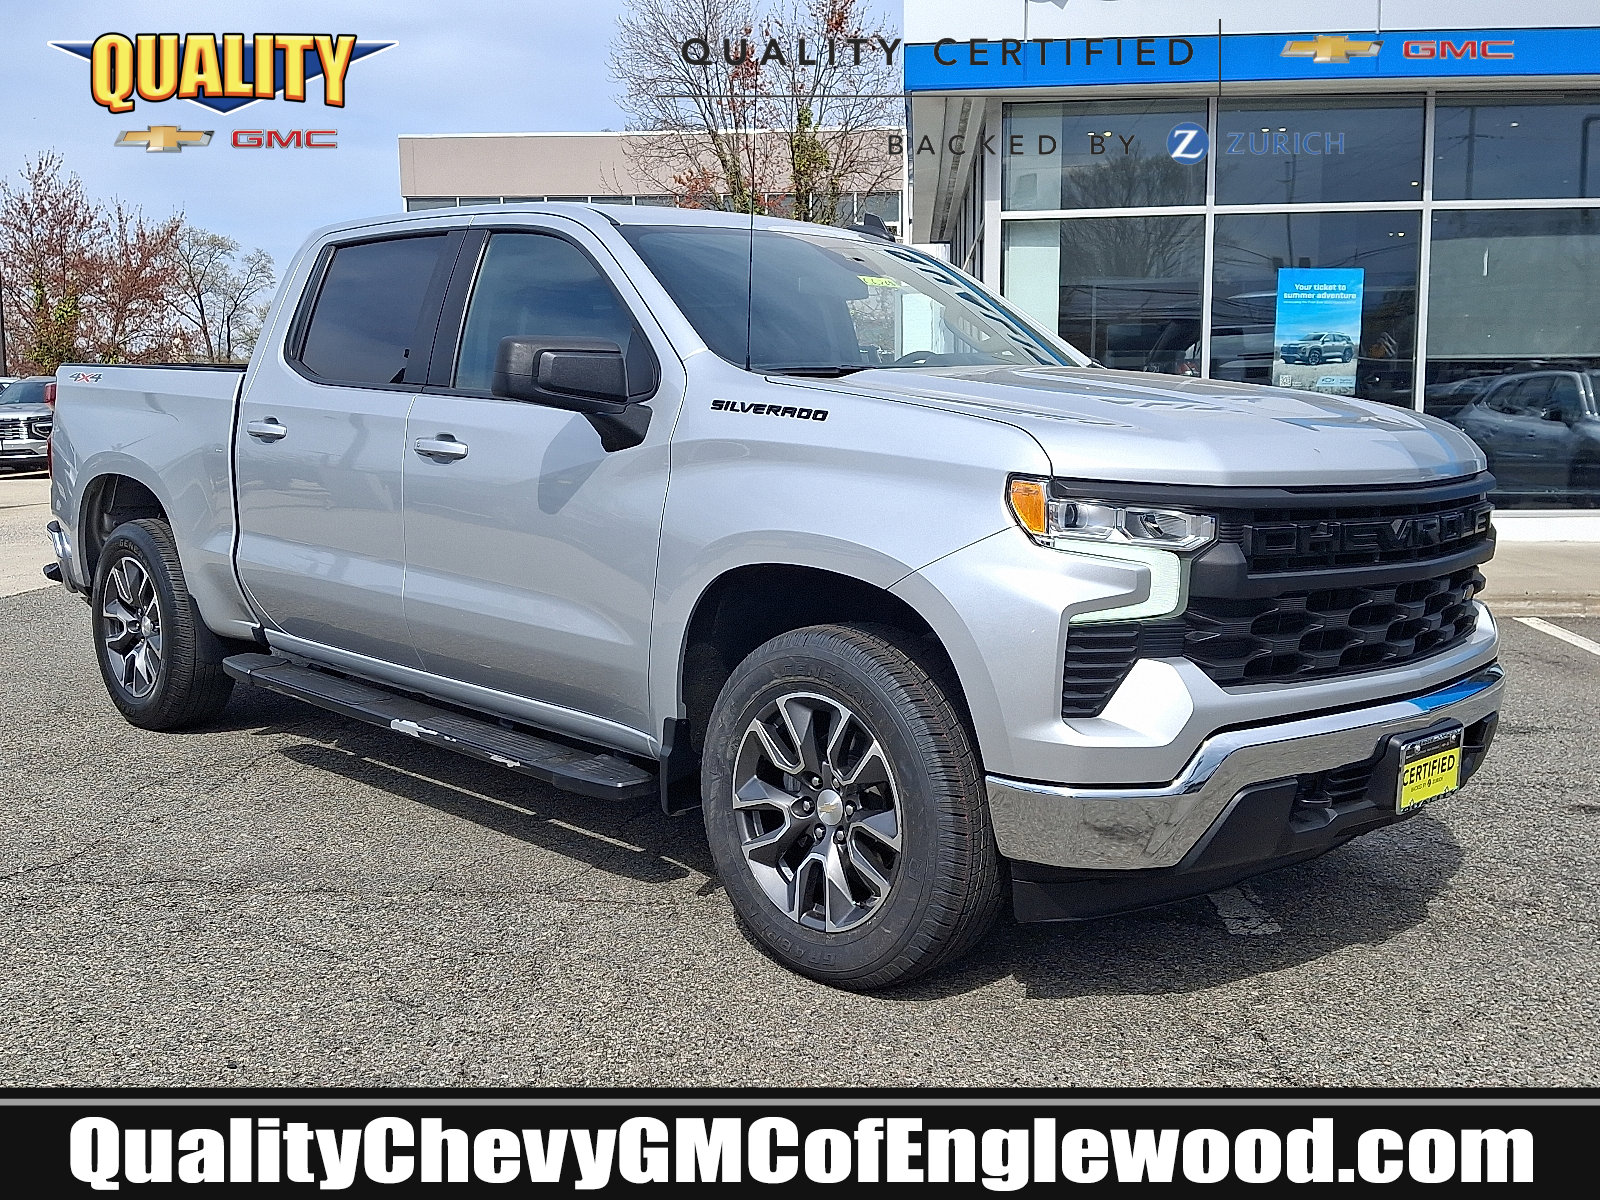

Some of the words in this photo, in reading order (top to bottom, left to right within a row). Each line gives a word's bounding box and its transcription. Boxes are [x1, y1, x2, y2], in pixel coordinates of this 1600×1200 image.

[710, 399, 829, 421] SILVERADO
[1243, 506, 1493, 556] CHEVROLE
[1402, 754, 1456, 787] CERTIFIED
